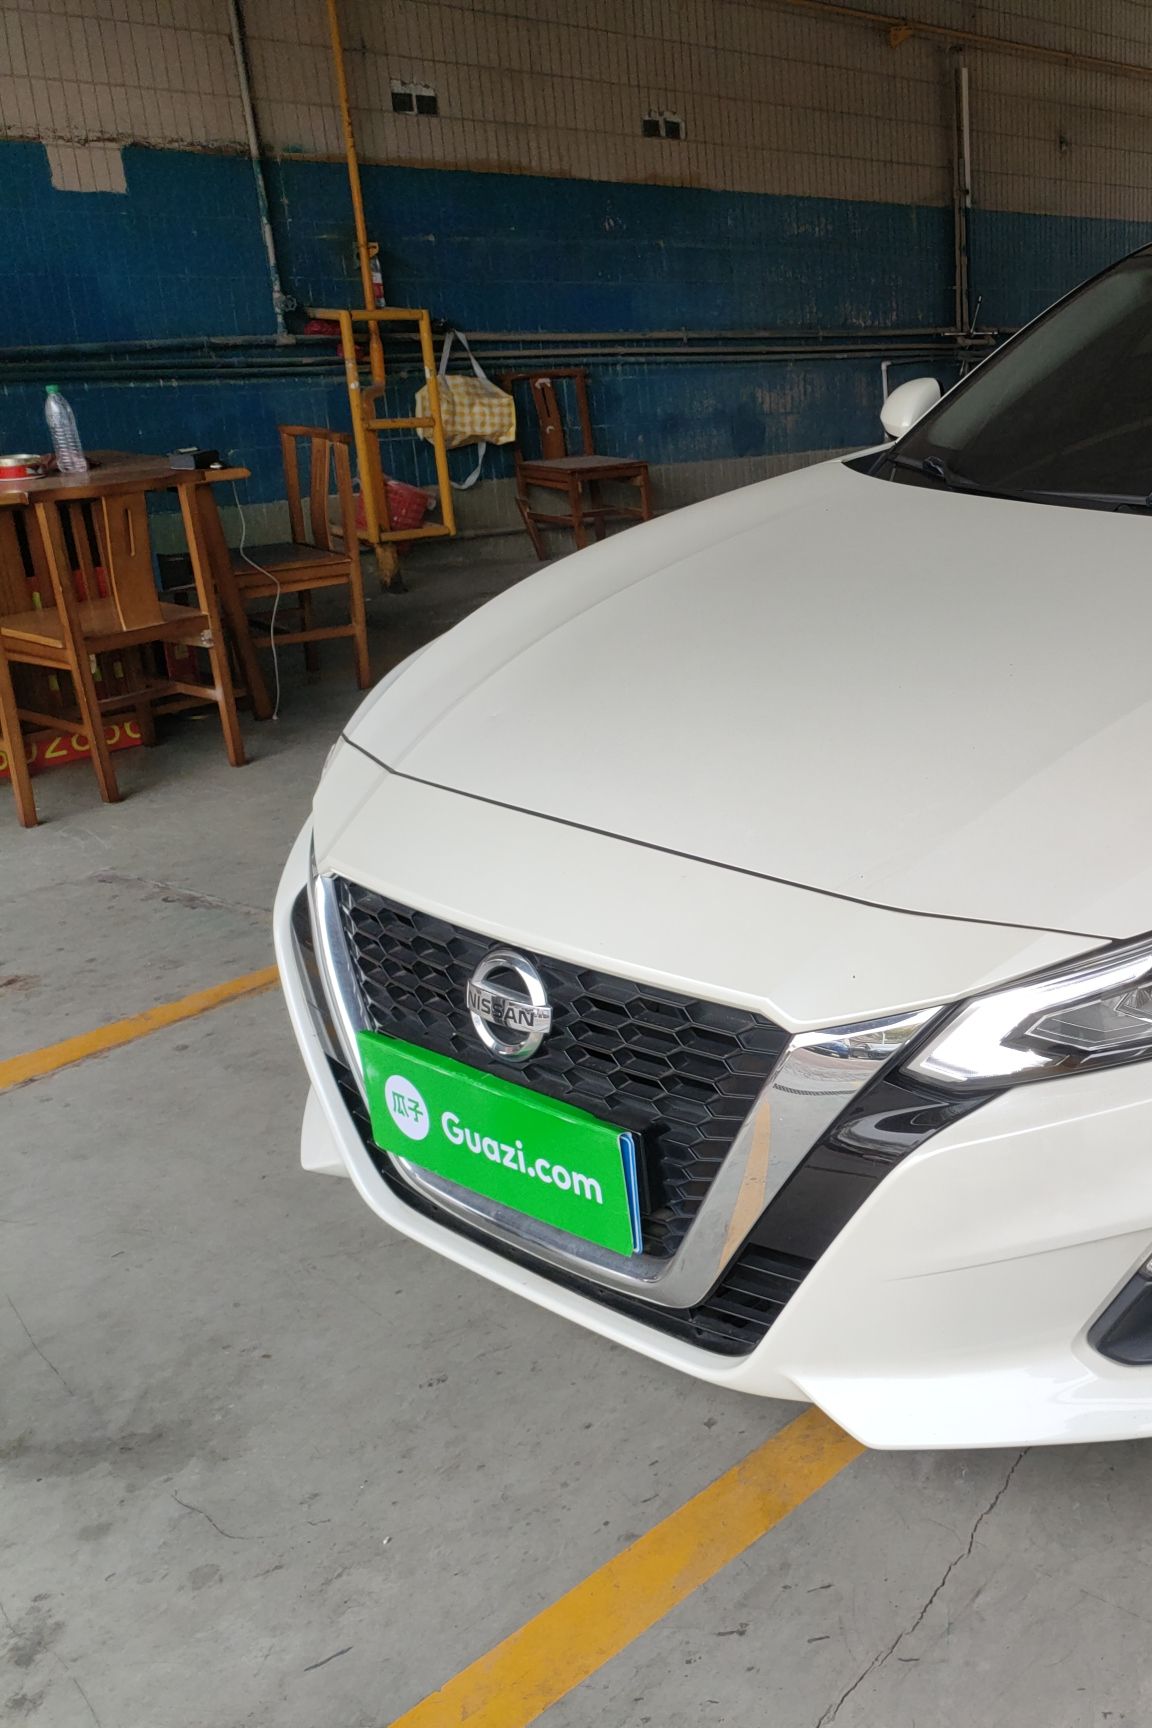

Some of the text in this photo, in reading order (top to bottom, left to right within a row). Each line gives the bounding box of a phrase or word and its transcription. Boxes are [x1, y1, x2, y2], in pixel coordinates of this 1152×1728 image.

[468, 989, 535, 1027] NISSAN
[391, 1090, 424, 1123] 瓜子
[441, 1111, 603, 1205] Guazi.com
